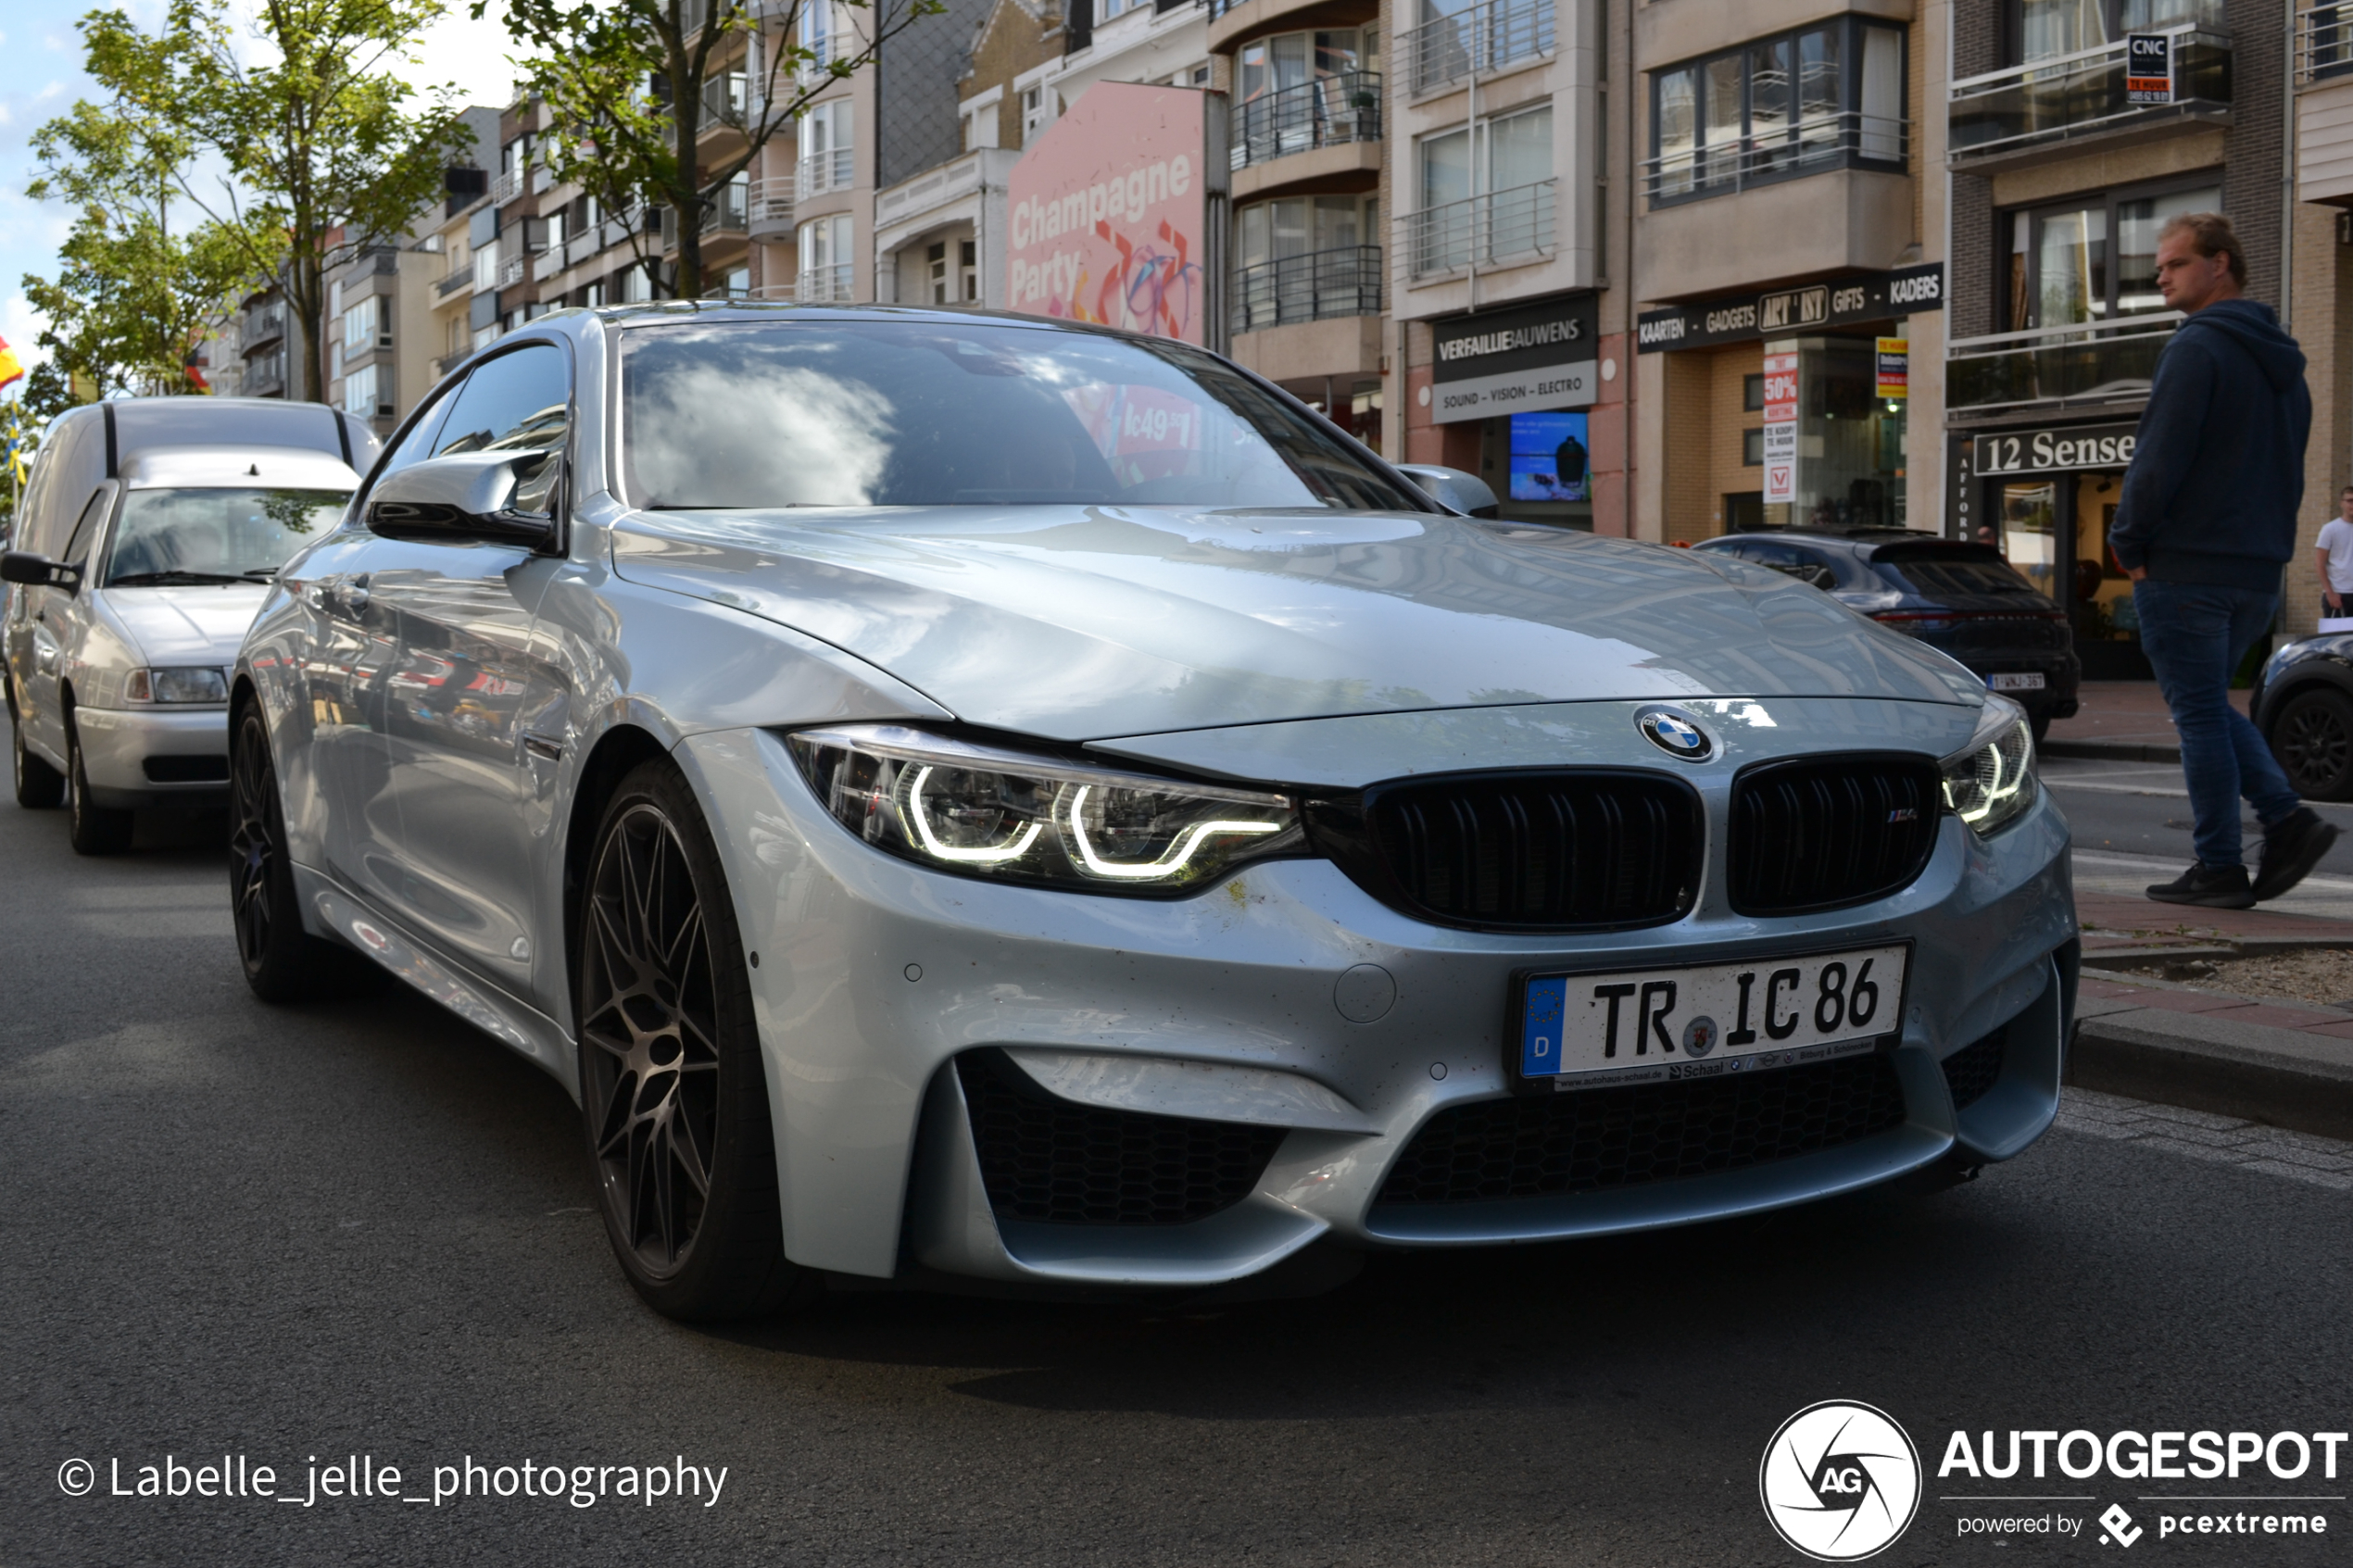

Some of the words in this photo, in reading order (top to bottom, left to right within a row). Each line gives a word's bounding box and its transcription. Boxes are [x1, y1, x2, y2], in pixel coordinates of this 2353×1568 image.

[2132, 40, 2165, 55] CNC
[2131, 80, 2140, 89] TE
[2143, 80, 2168, 89] HUUR
[1013, 154, 1190, 250] Champagne
[1011, 250, 1080, 307] Party
[1832, 287, 1864, 312] GIFTS
[1890, 274, 1939, 304] KADERS
[1640, 318, 1684, 344] KAARTEN
[1706, 306, 1755, 333] GADGETS
[1444, 393, 1478, 408] SOUND
[1491, 385, 1526, 401] VISION
[1538, 377, 1582, 395] ELECTRO
[1765, 374, 1796, 400] 50%
[1766, 427, 1773, 436] TE
[1767, 438, 1774, 447] TE
[1776, 436, 1793, 446] HUUR
[1987, 437, 2021, 471] 12
[1594, 980, 1677, 1058] TR
[1727, 968, 1800, 1047] IC
[1814, 958, 1879, 1033] 86
[1534, 1036, 1549, 1058] D
[1800, 1049, 1824, 1060] Bitburg
[1834, 1041, 1872, 1054] Schönecken
[1561, 1071, 1662, 1087] www.autohaus-schaal.de
[1683, 1061, 1724, 1077] Schaal
